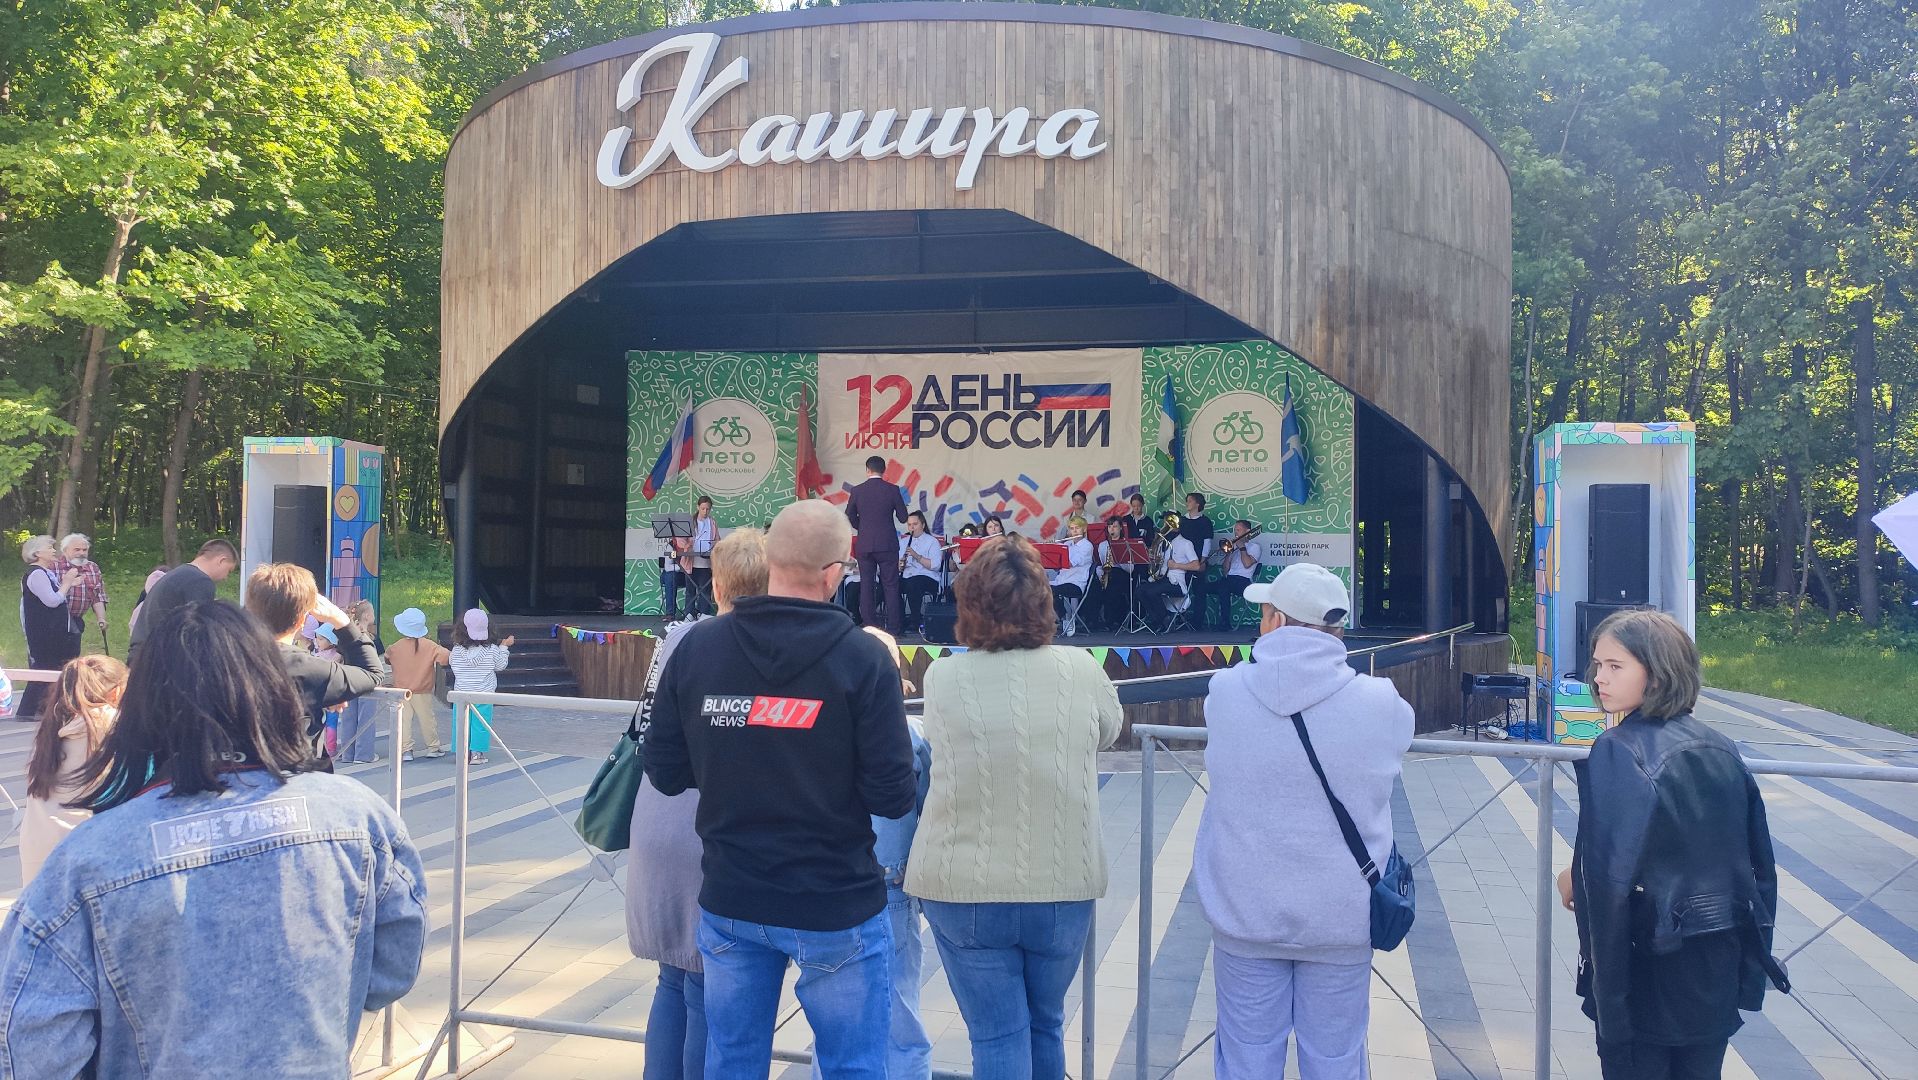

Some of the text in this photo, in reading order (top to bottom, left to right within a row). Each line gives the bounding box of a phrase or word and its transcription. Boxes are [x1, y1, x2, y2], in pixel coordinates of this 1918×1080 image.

[597, 32, 1107, 190] Кашира
[847, 374, 912, 433] 12
[912, 374, 1041, 411] ДЕНЬ
[845, 432, 912, 449] ИЮНЯ
[912, 410, 1110, 449] РОССИИ
[703, 698, 818, 725] BLNCG 24/7
[711, 715, 746, 728] NEWS
